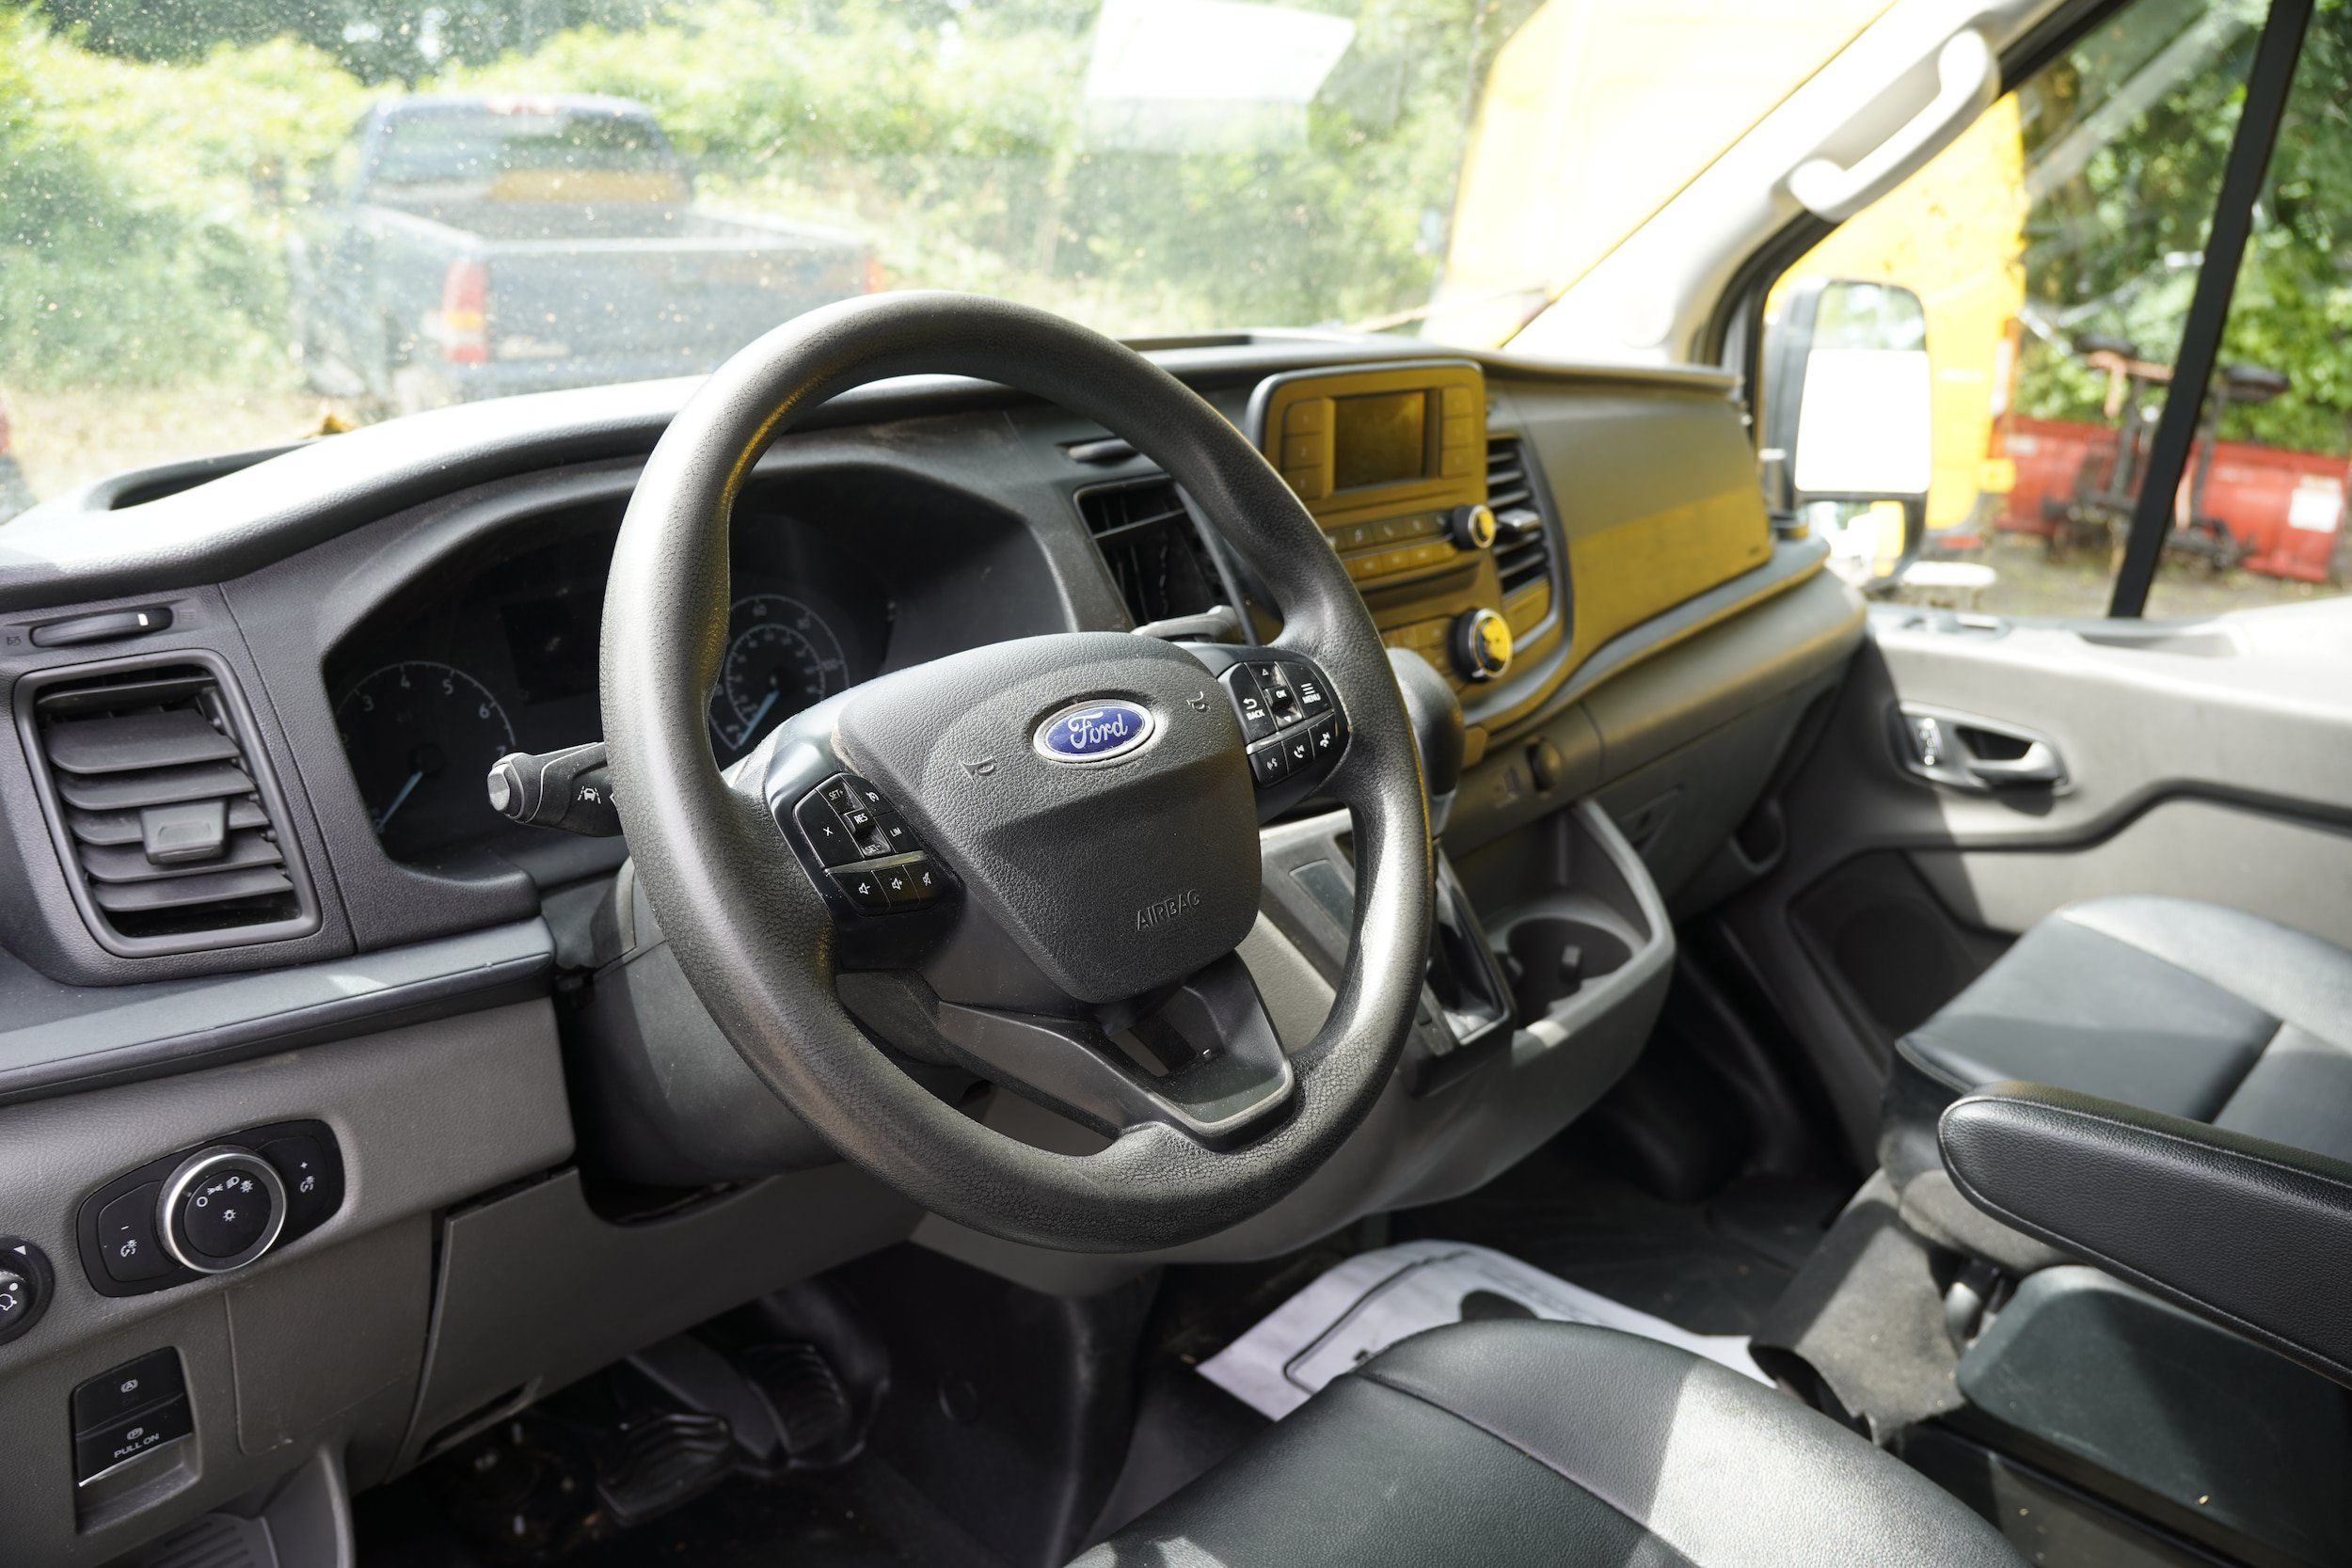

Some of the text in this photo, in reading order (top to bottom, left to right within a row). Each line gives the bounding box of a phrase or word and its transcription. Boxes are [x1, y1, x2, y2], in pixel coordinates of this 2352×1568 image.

[401, 674, 411, 689] 4
[442, 678, 454, 696] 5
[1275, 689, 1287, 699] OK
[1302, 693, 1321, 705] MENU
[364, 695, 375, 712] 3
[479, 703, 491, 720] 6
[1246, 709, 1265, 721] BACK
[1069, 711, 1128, 750] Ford
[853, 813, 868, 824] RES
[889, 827, 902, 837] LIM
[1136, 889, 1200, 931] AIRBAG
[114, 1433, 160, 1458] PULL ON
